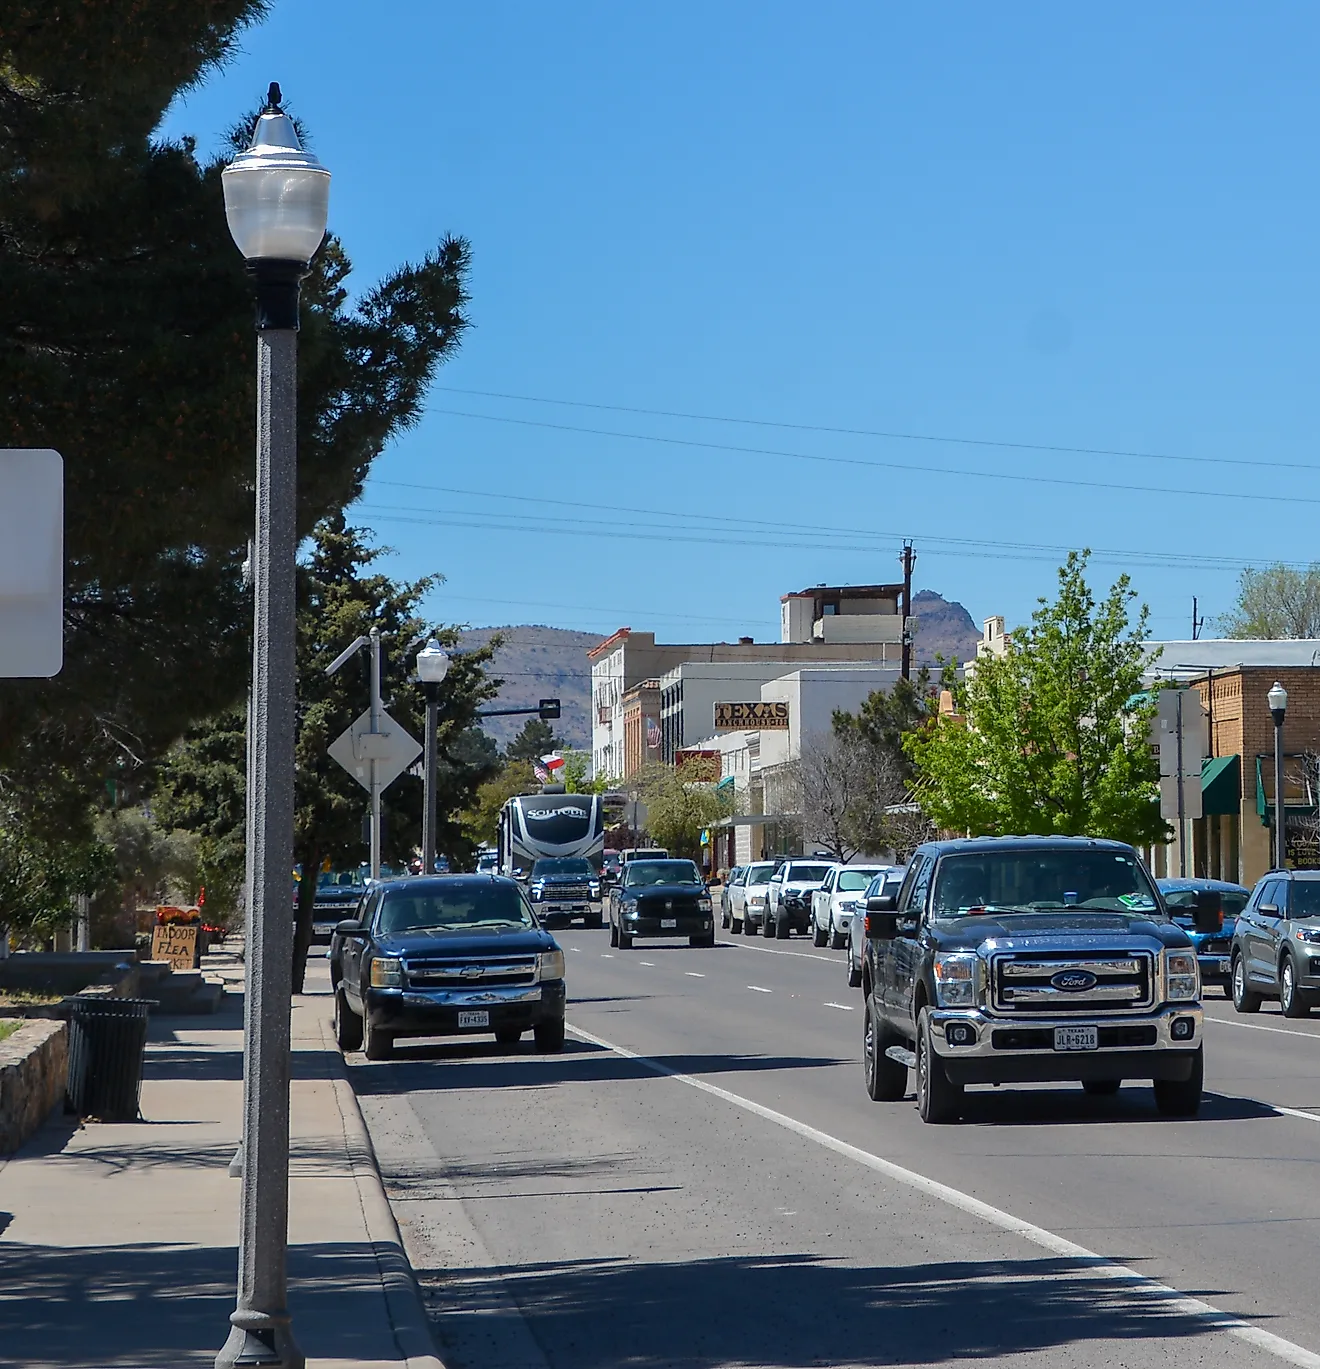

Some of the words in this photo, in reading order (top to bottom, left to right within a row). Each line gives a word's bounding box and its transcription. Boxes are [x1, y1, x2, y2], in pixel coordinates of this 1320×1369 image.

[715, 702, 787, 718] TEXAS
[527, 808, 587, 818] SOLITUDE
[157, 926, 195, 940] INDOOR
[157, 942, 189, 956] FLEA
[1061, 974, 1087, 986] Ford
